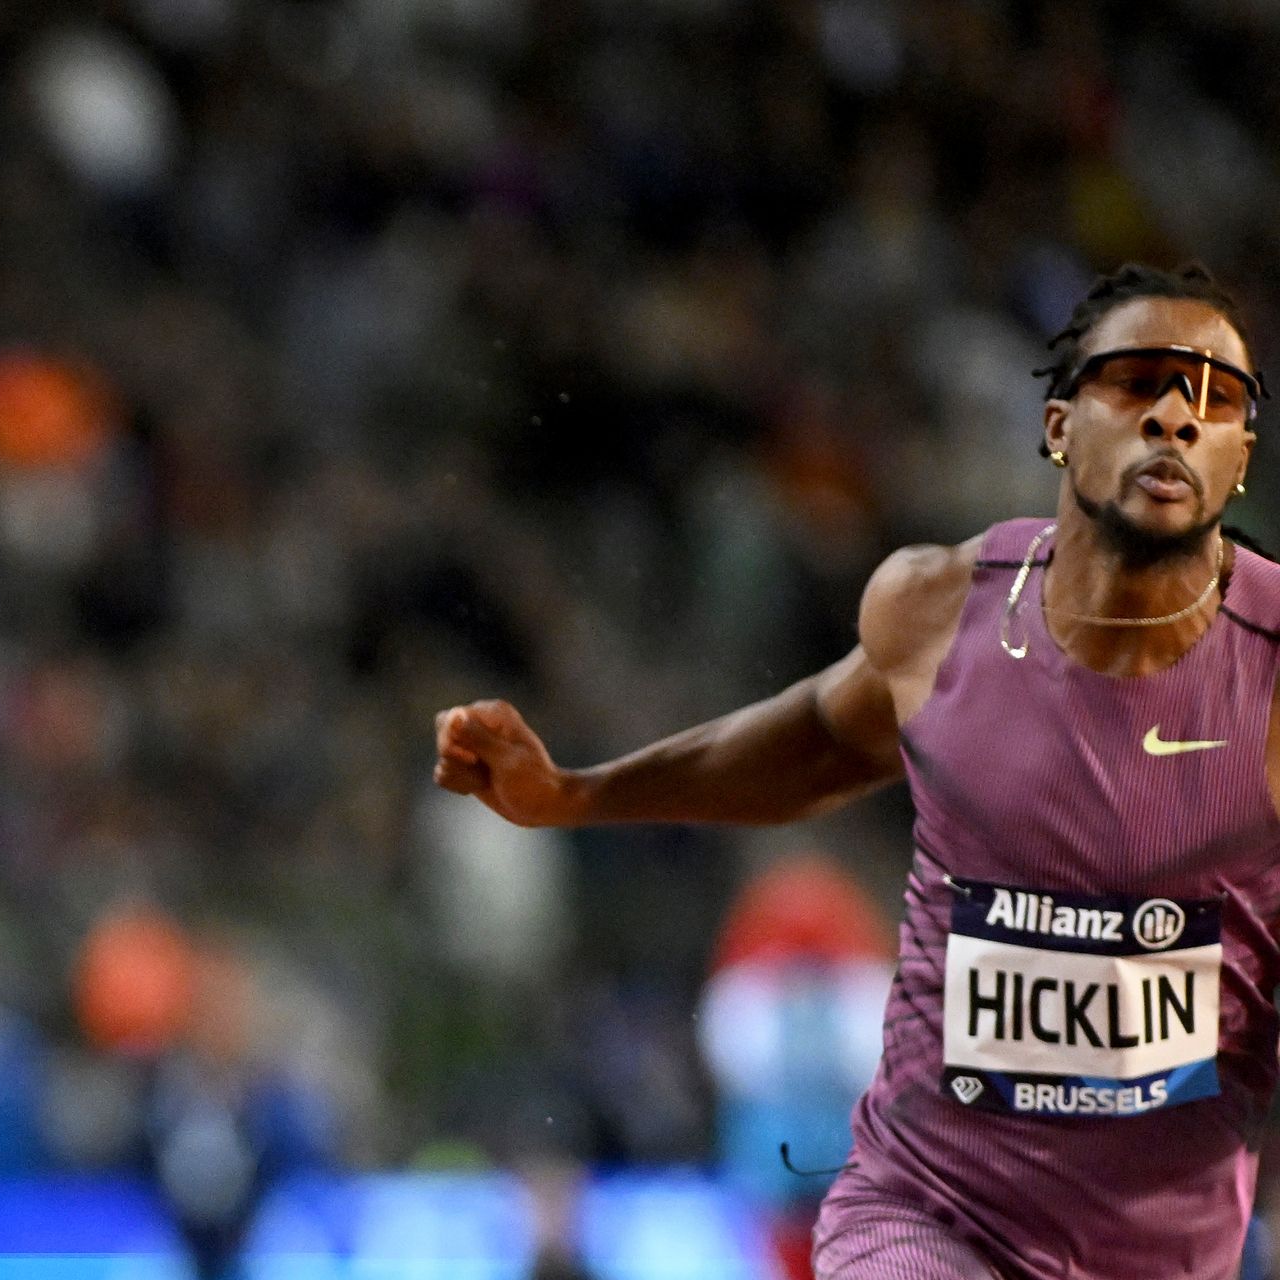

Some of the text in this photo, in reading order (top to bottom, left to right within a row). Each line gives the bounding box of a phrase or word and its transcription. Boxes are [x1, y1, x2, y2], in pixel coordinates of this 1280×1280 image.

[986, 888, 1123, 942] Allianz
[967, 967, 1196, 1050] HICKLIN
[1014, 1078, 1168, 1114] BRUSSELS
